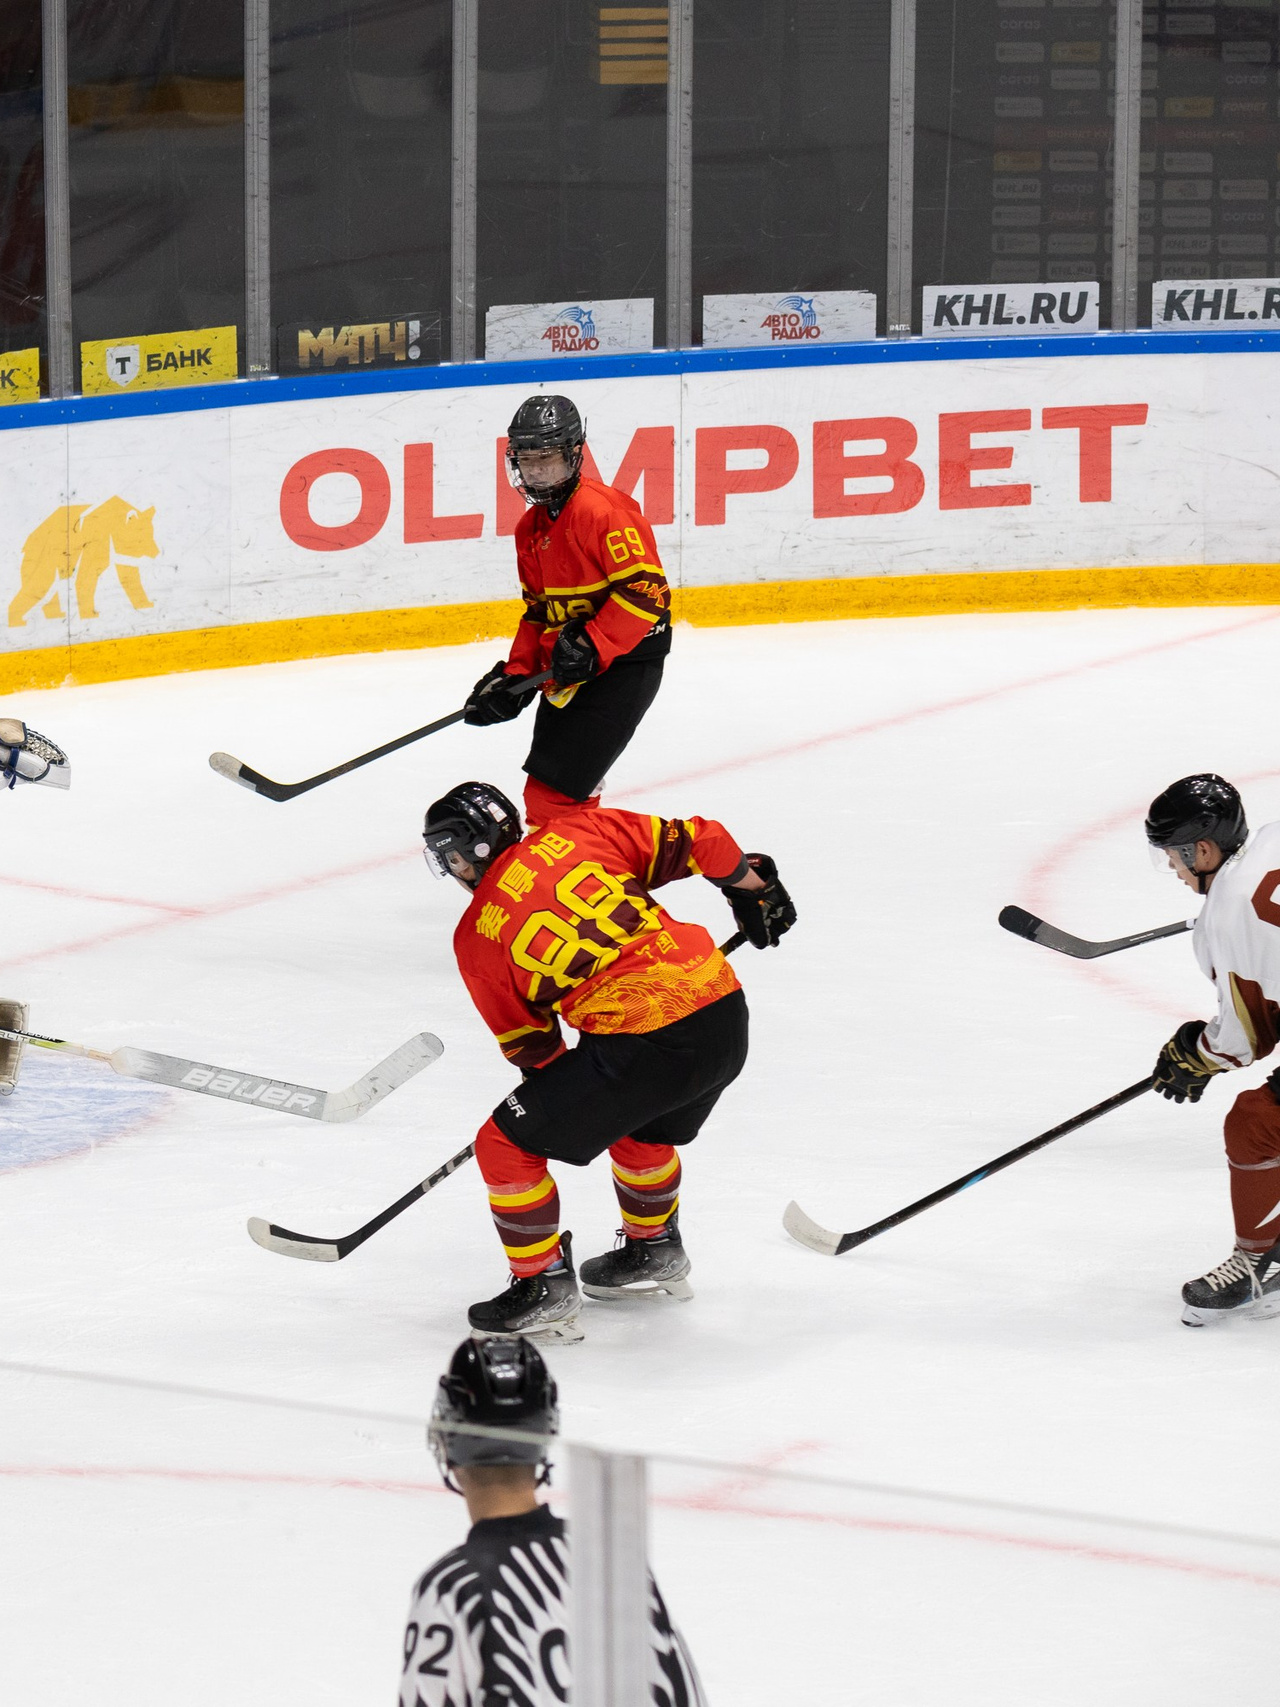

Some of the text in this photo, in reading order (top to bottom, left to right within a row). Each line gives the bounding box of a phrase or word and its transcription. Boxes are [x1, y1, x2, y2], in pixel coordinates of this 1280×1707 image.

[760, 313, 800, 329] АВТО
[933, 291, 1089, 327] KHL.RU
[541, 324, 580, 340] АВТО
[551, 337, 600, 352] РАДИО
[771, 326, 821, 341] РАДИО
[146, 348, 212, 373] БАНК
[279, 403, 1149, 553] OLIMPBET
[605, 526, 646, 564] 69
[509, 859, 664, 990] 88
[180, 1067, 317, 1113] BAUER
